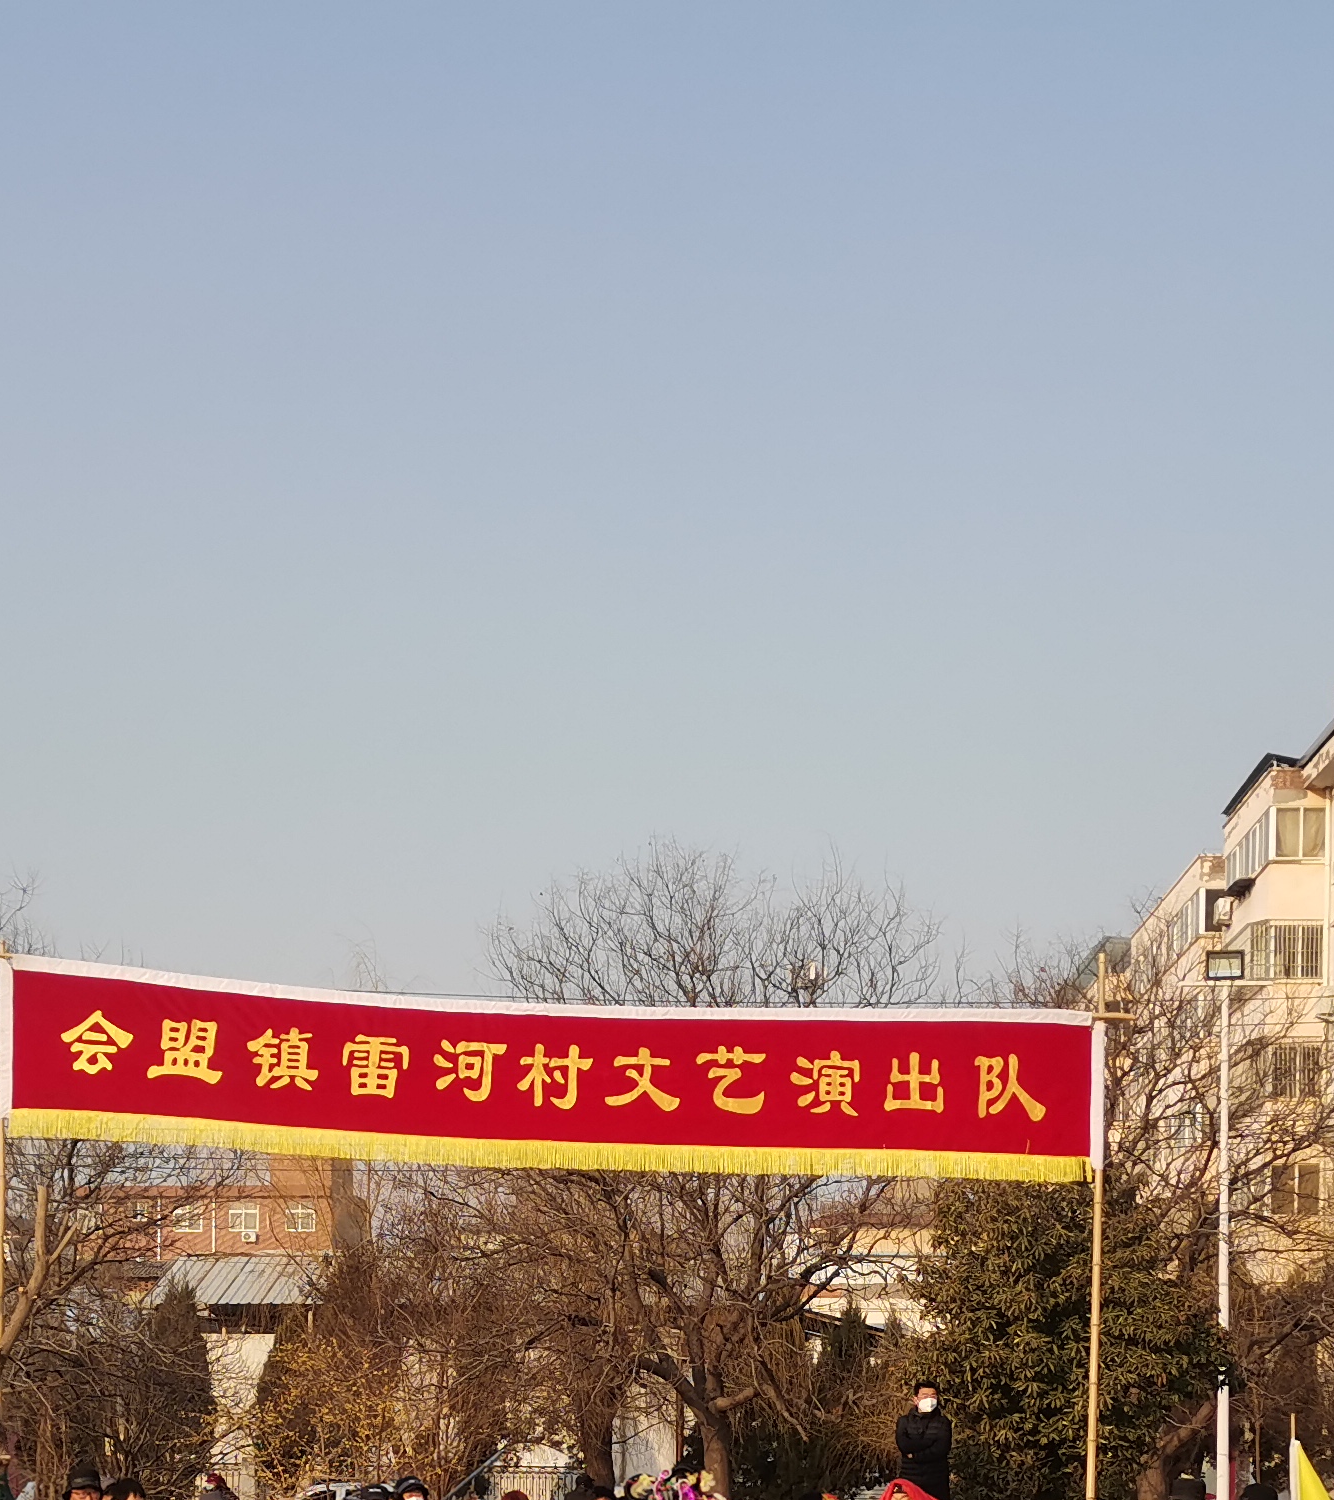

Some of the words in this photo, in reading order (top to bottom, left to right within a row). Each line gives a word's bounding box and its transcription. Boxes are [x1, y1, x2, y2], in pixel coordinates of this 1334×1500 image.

[60, 1009, 1048, 1122] 会盟镇雷河村文艺演出队
